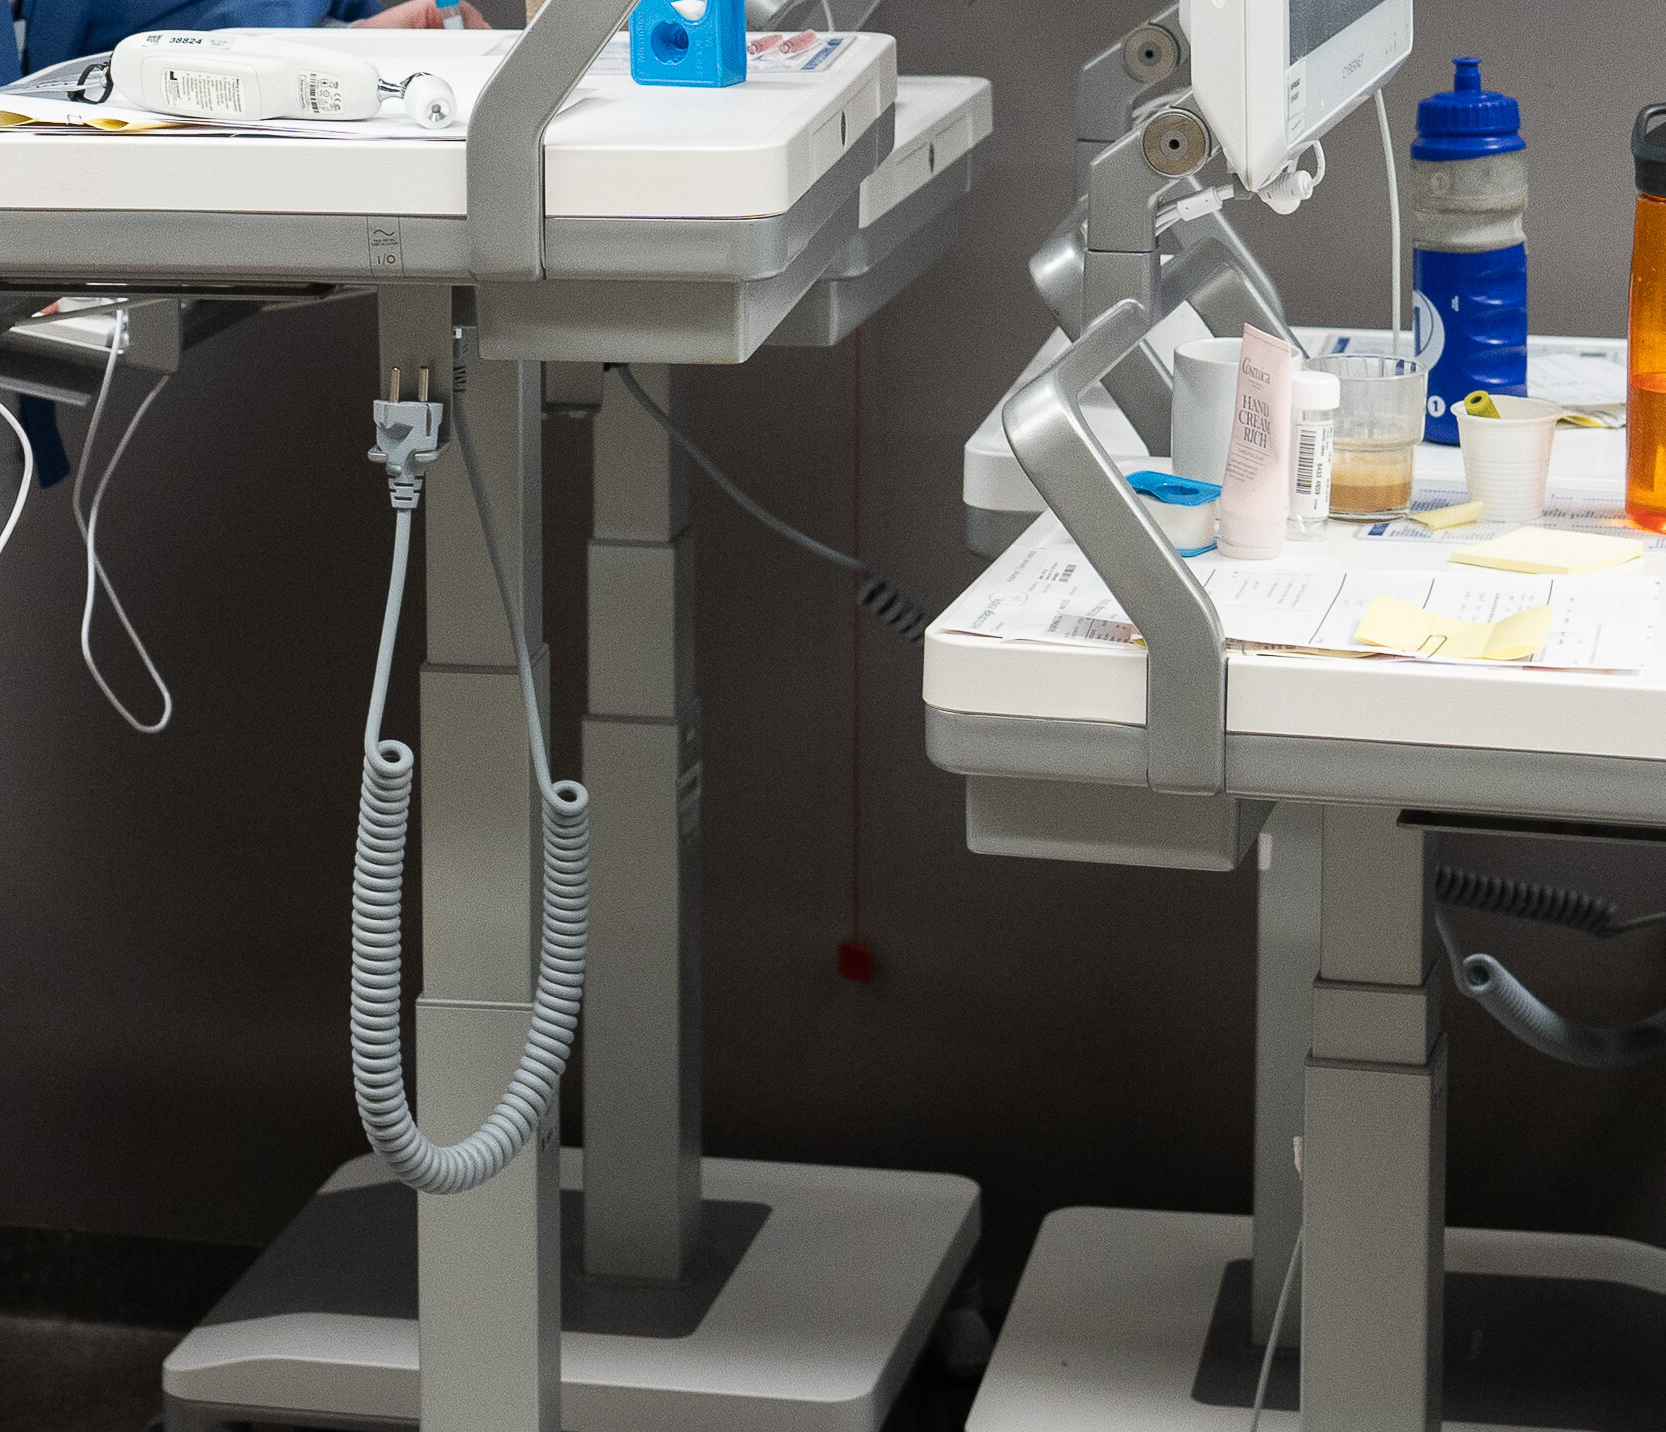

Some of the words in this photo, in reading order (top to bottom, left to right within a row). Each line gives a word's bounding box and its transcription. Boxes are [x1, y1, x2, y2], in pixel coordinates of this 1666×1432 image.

[169, 36, 203, 46] 38824
[1243, 394, 1269, 417] HAND
[1238, 410, 1271, 435] CREAM
[1244, 428, 1267, 449] RICH
